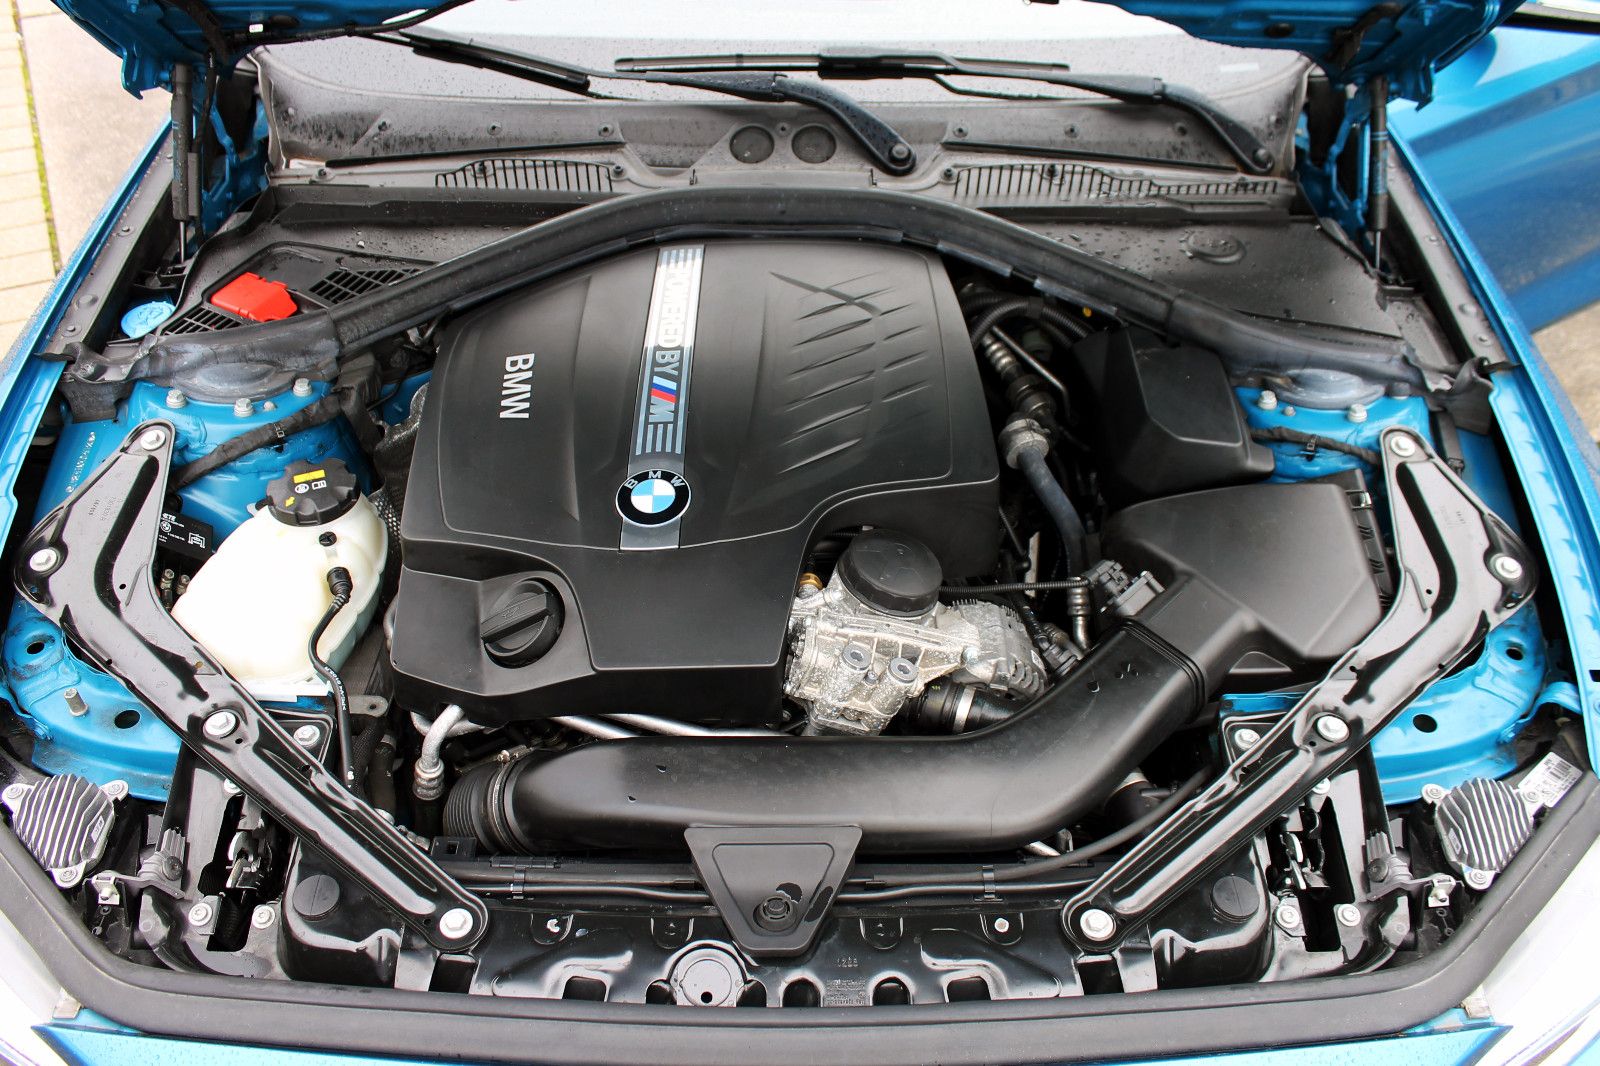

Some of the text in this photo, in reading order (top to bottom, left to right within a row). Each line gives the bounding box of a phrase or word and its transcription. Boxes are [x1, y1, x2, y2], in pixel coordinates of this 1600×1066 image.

[658, 268, 688, 348] POWERED
[654, 350, 682, 375] BY
[500, 353, 535, 419] BMW
[624, 470, 686, 489] BMW
